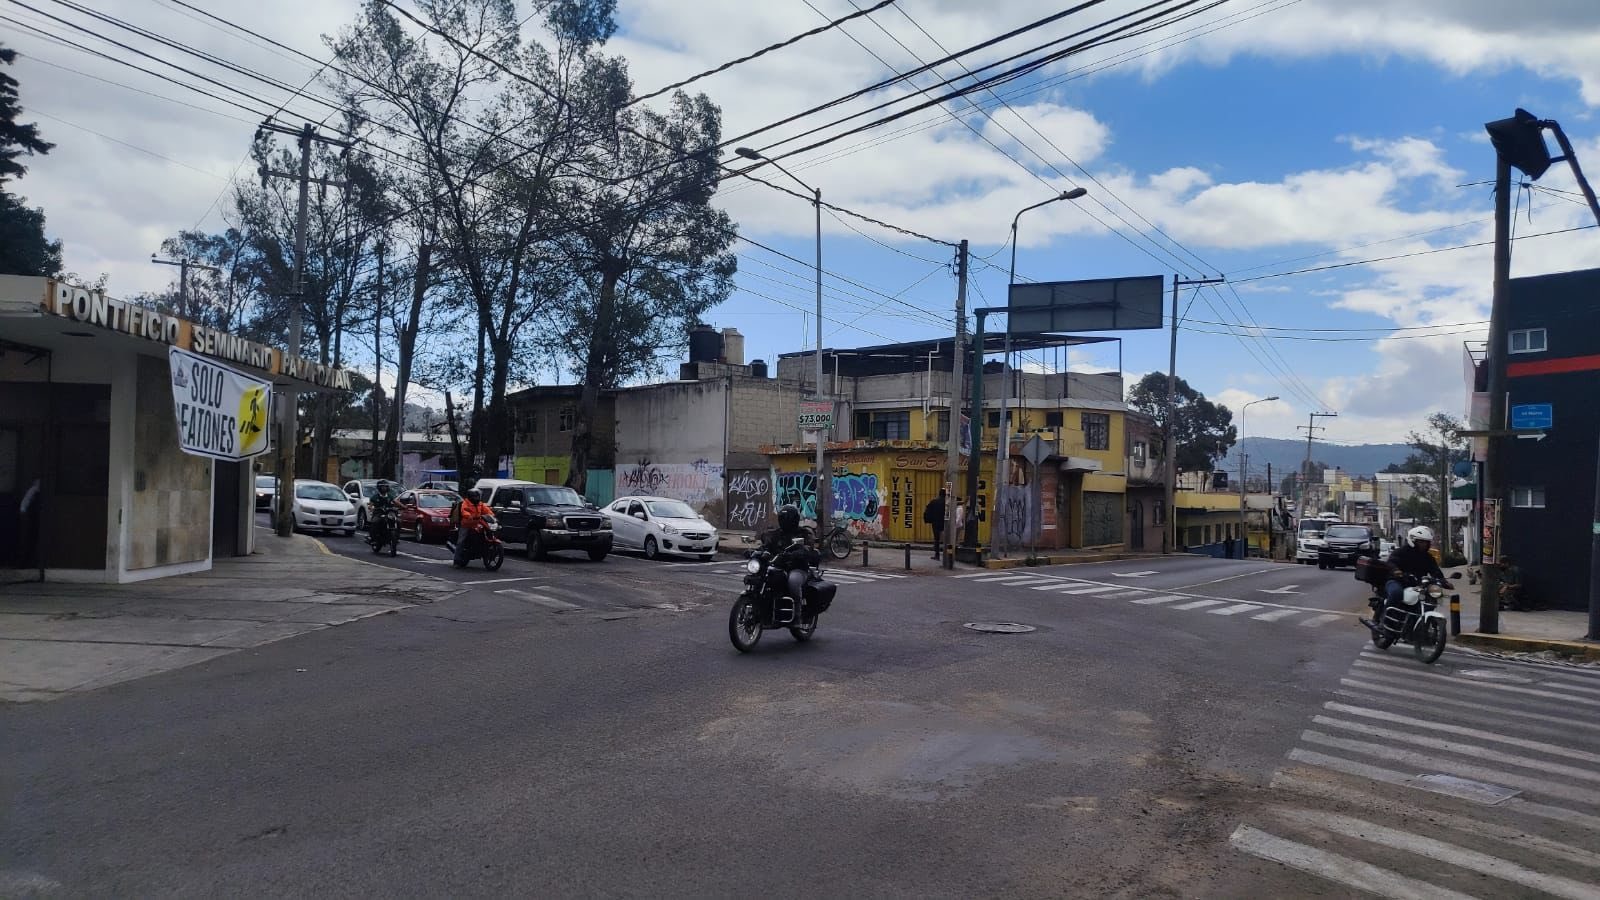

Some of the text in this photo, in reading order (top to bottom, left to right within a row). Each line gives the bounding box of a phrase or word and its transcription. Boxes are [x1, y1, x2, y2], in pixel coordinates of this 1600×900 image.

[56, 281, 180, 344] PONTIFICIO
[192, 325, 273, 369] SEMINARIO
[191, 362, 224, 408] SOLO
[177, 403, 236, 454] EATONES
